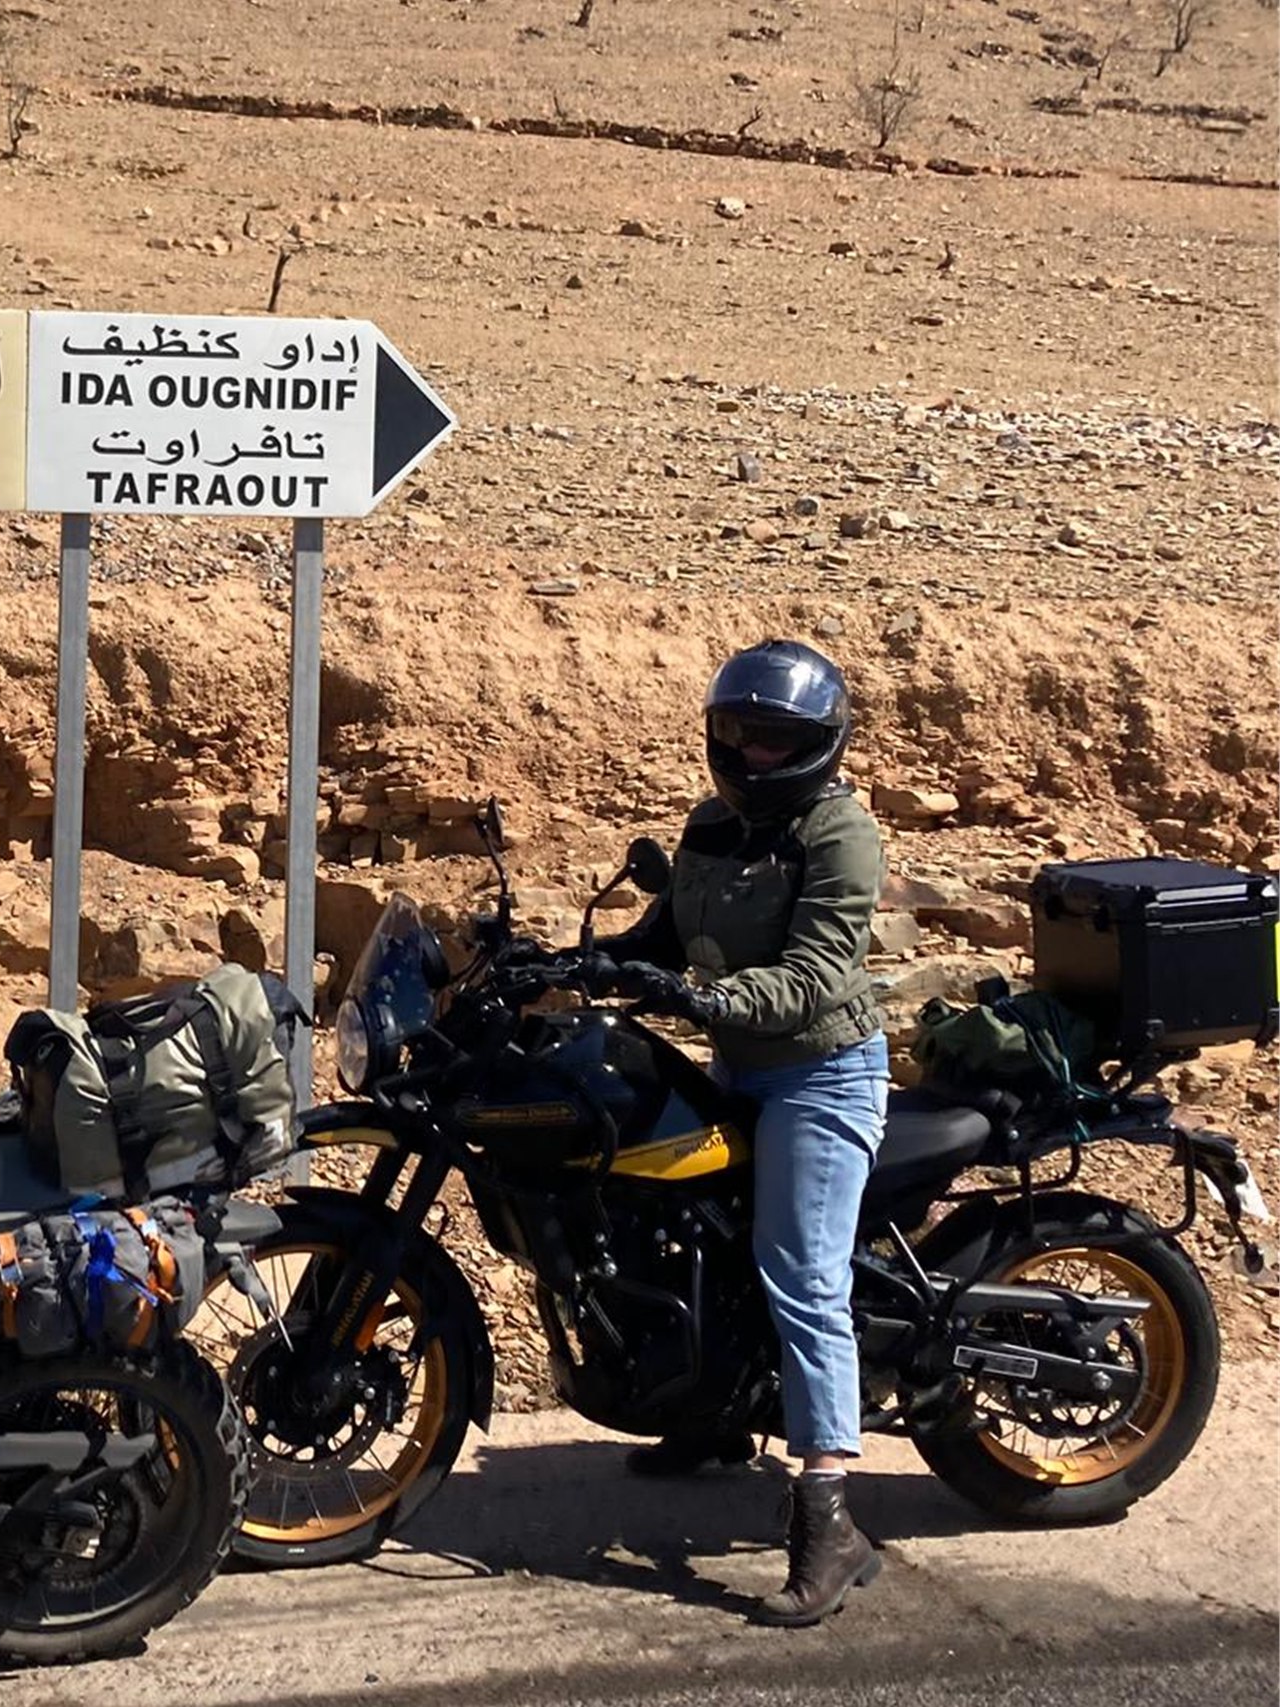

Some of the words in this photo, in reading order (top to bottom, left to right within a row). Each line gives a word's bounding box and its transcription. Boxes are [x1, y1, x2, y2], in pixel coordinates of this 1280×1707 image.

[61, 324, 240, 367] كنظيف
[262, 332, 361, 374] إداو
[61, 371, 133, 407] IDA
[148, 374, 358, 411] OUGNIDIF
[92, 424, 325, 467] تافراوت
[86, 471, 329, 508] TAFRAOUT
